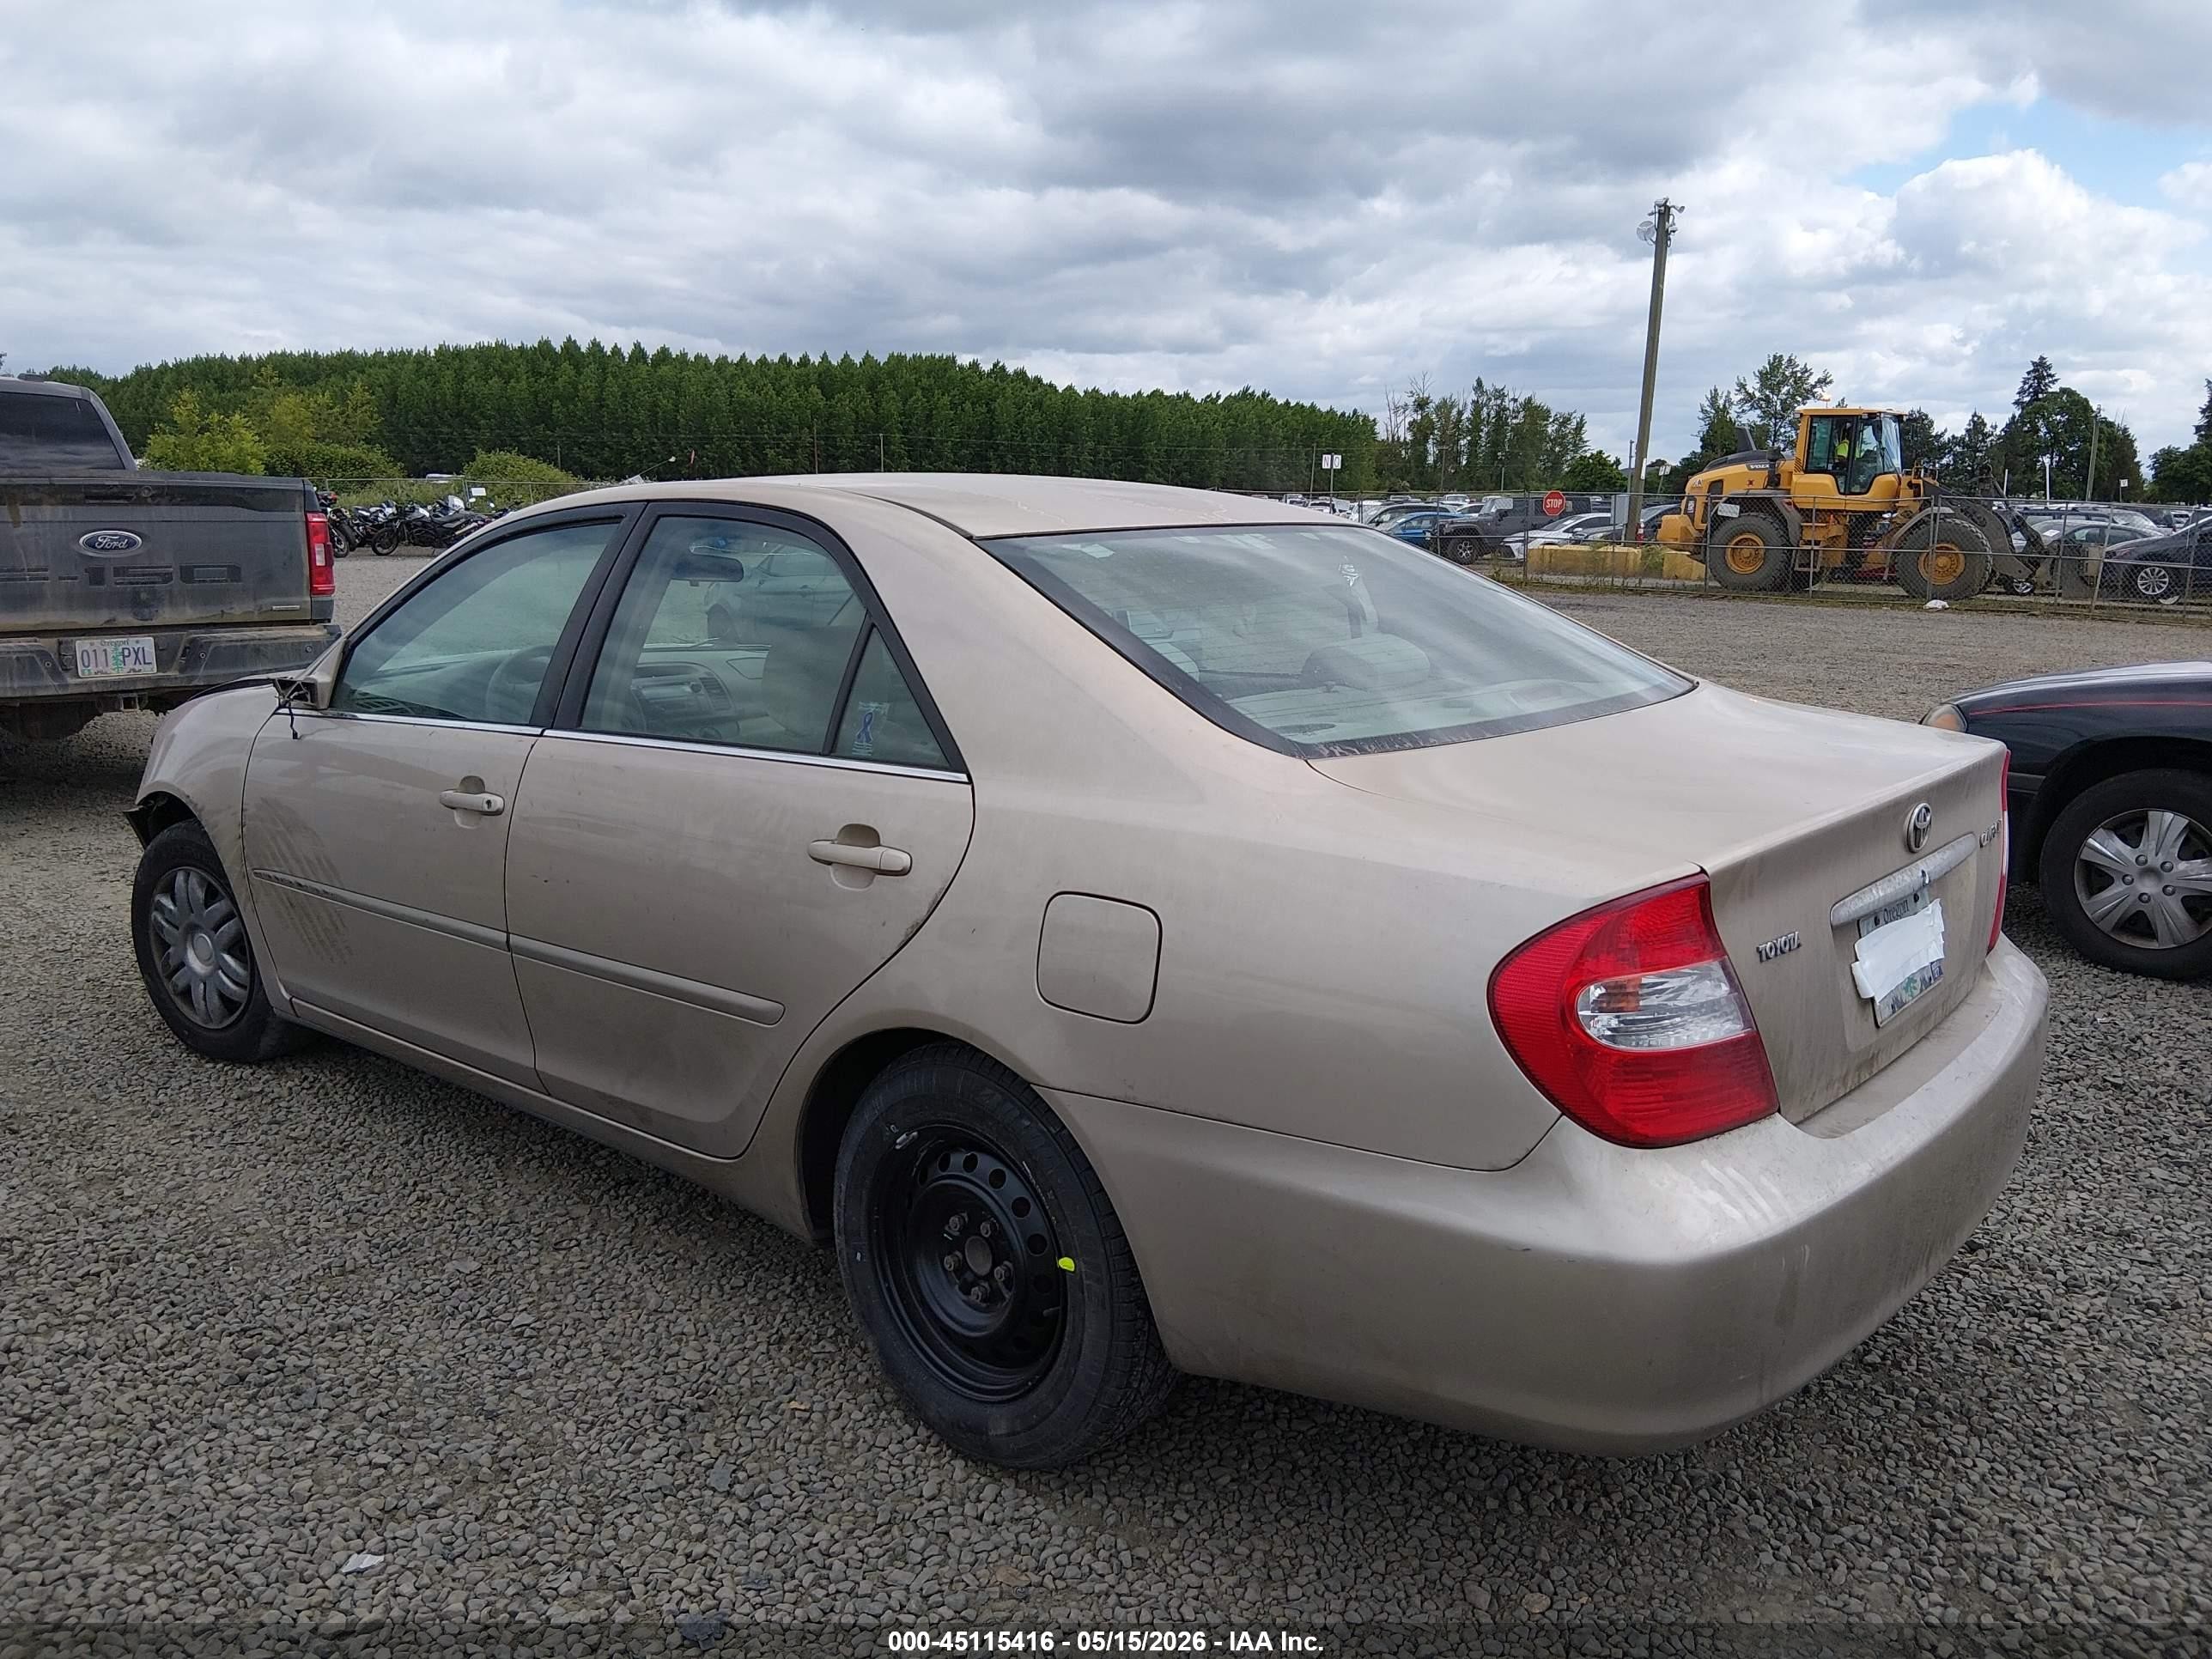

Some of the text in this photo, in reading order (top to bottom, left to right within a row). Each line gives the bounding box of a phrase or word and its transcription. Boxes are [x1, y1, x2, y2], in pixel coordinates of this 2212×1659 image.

[1546, 499, 1563, 508] STOP
[94, 535, 128, 550] Ford
[81, 647, 152, 668] 011 PXL
[1883, 899, 1910, 924] Oregon
